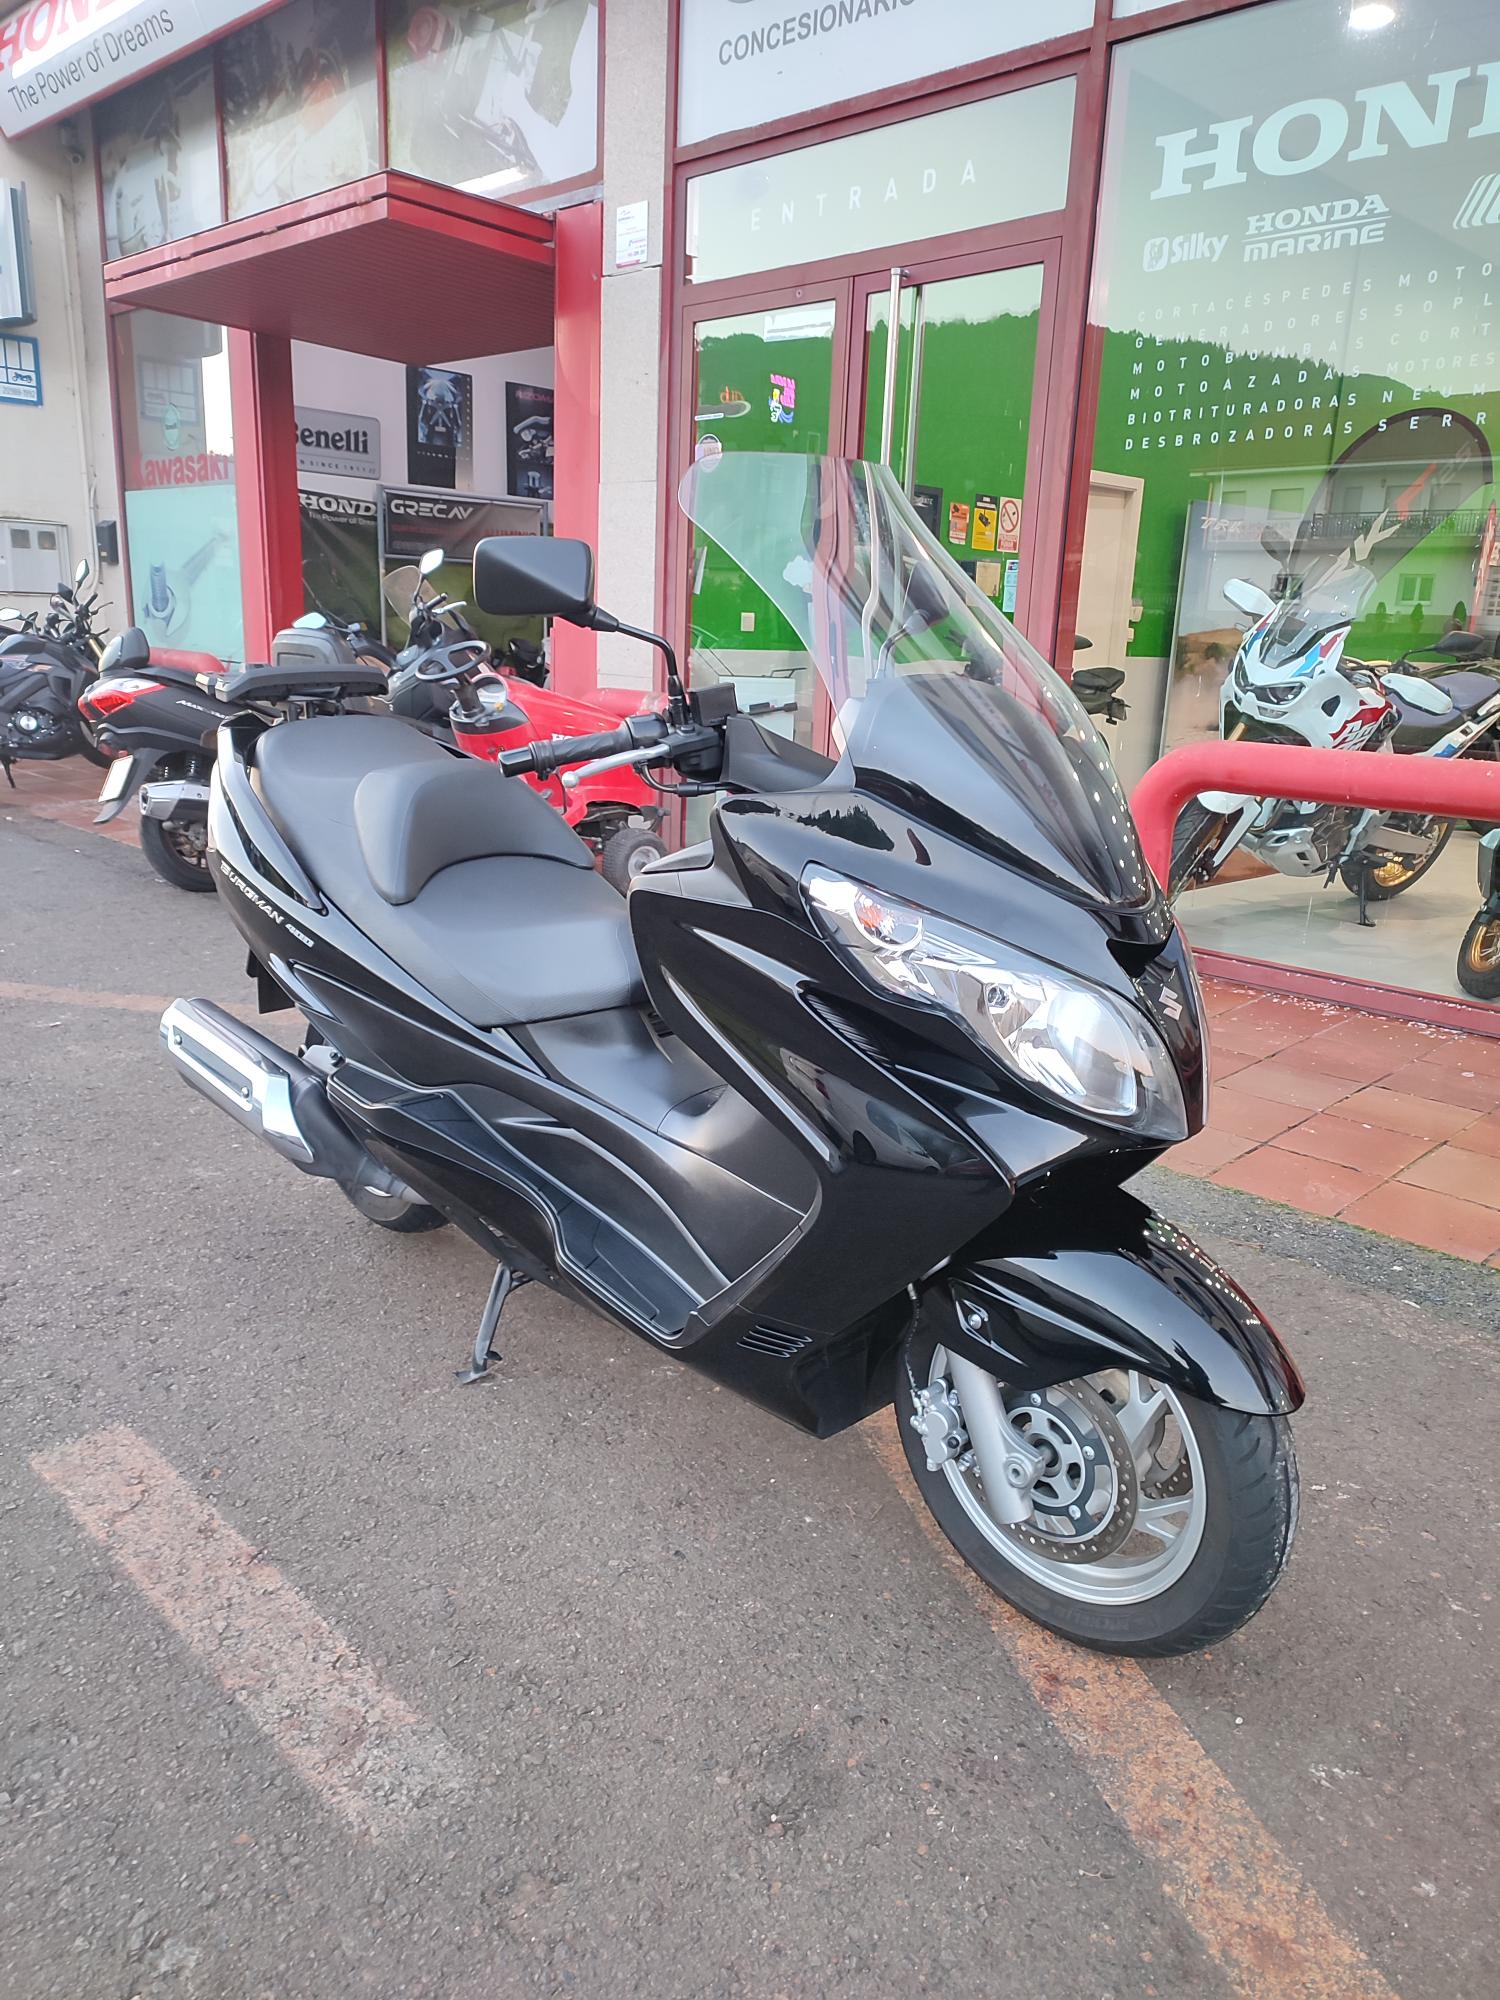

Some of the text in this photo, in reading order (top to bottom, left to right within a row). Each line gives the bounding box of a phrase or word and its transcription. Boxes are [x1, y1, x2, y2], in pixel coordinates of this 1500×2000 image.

[0, 0, 113, 71] HON
[8, 9, 175, 113] The Power of Dreams
[750, 159, 976, 231] ENTRADA
[1245, 194, 1390, 235] HONDA
[1171, 232, 1229, 264] Silky
[1398, 262, 1493, 288] MOTO
[1135, 293, 1493, 349] GENERADORES SOPL
[1130, 351, 1496, 400] MOTOAZADAS MOTORES
[1132, 336, 1364, 375] MOTOBOMBAS
[1127, 383, 1487, 425] BIOTRITURADORAS NEUM
[1124, 411, 1487, 450] DESBROZADORAS SERR
[298, 492, 378, 516] HOND
[390, 500, 474, 520] GRECAV
[220, 860, 315, 948] BURGMAN 400
